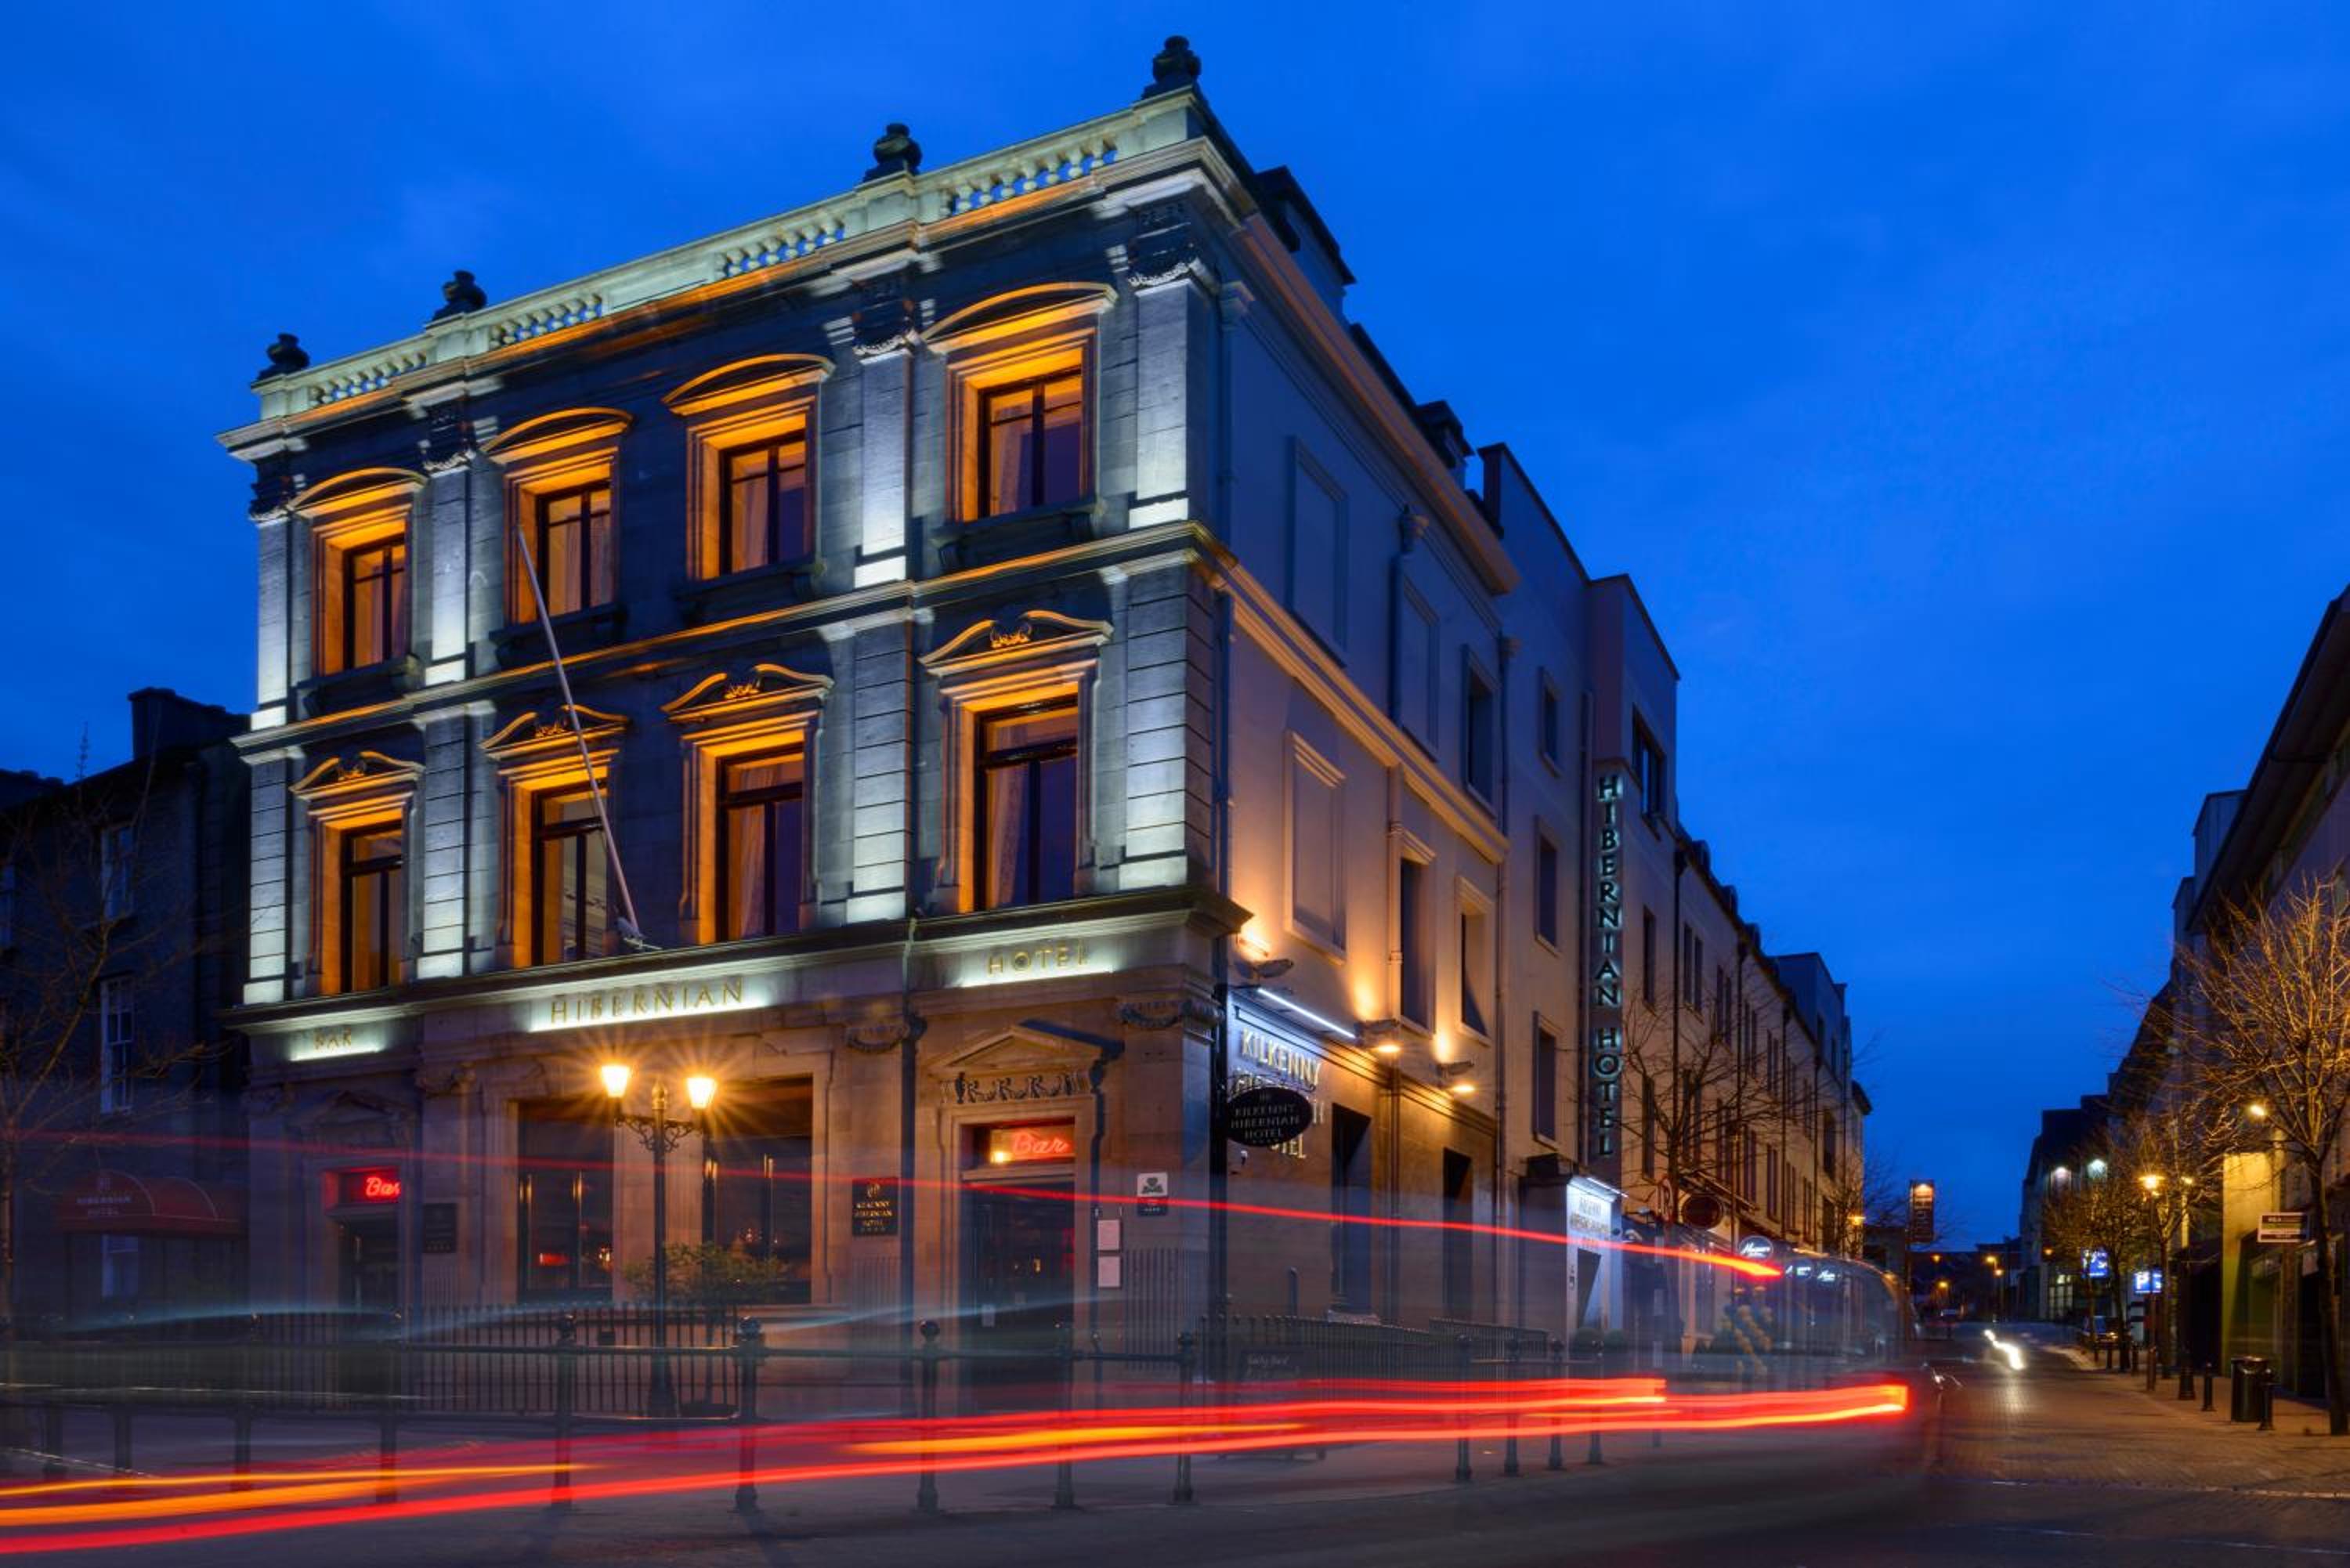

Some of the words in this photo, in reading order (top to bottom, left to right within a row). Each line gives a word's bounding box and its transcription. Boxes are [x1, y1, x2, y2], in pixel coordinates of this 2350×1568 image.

[1596, 775, 1622, 1007] HIBERNIAN
[989, 939, 1086, 976] HOTEL
[551, 977, 743, 1023] HIBERNIAN
[315, 1024, 352, 1051] BAR
[1241, 1028, 1322, 1087] KILKENNY
[1595, 1027, 1622, 1155] HOTEL
[1231, 1115, 1300, 1128] HIBERNIAN
[1235, 1104, 1296, 1116] KILKENNY
[1013, 1131, 1070, 1155] Bar
[1245, 1128, 1284, 1140] HOTEL
